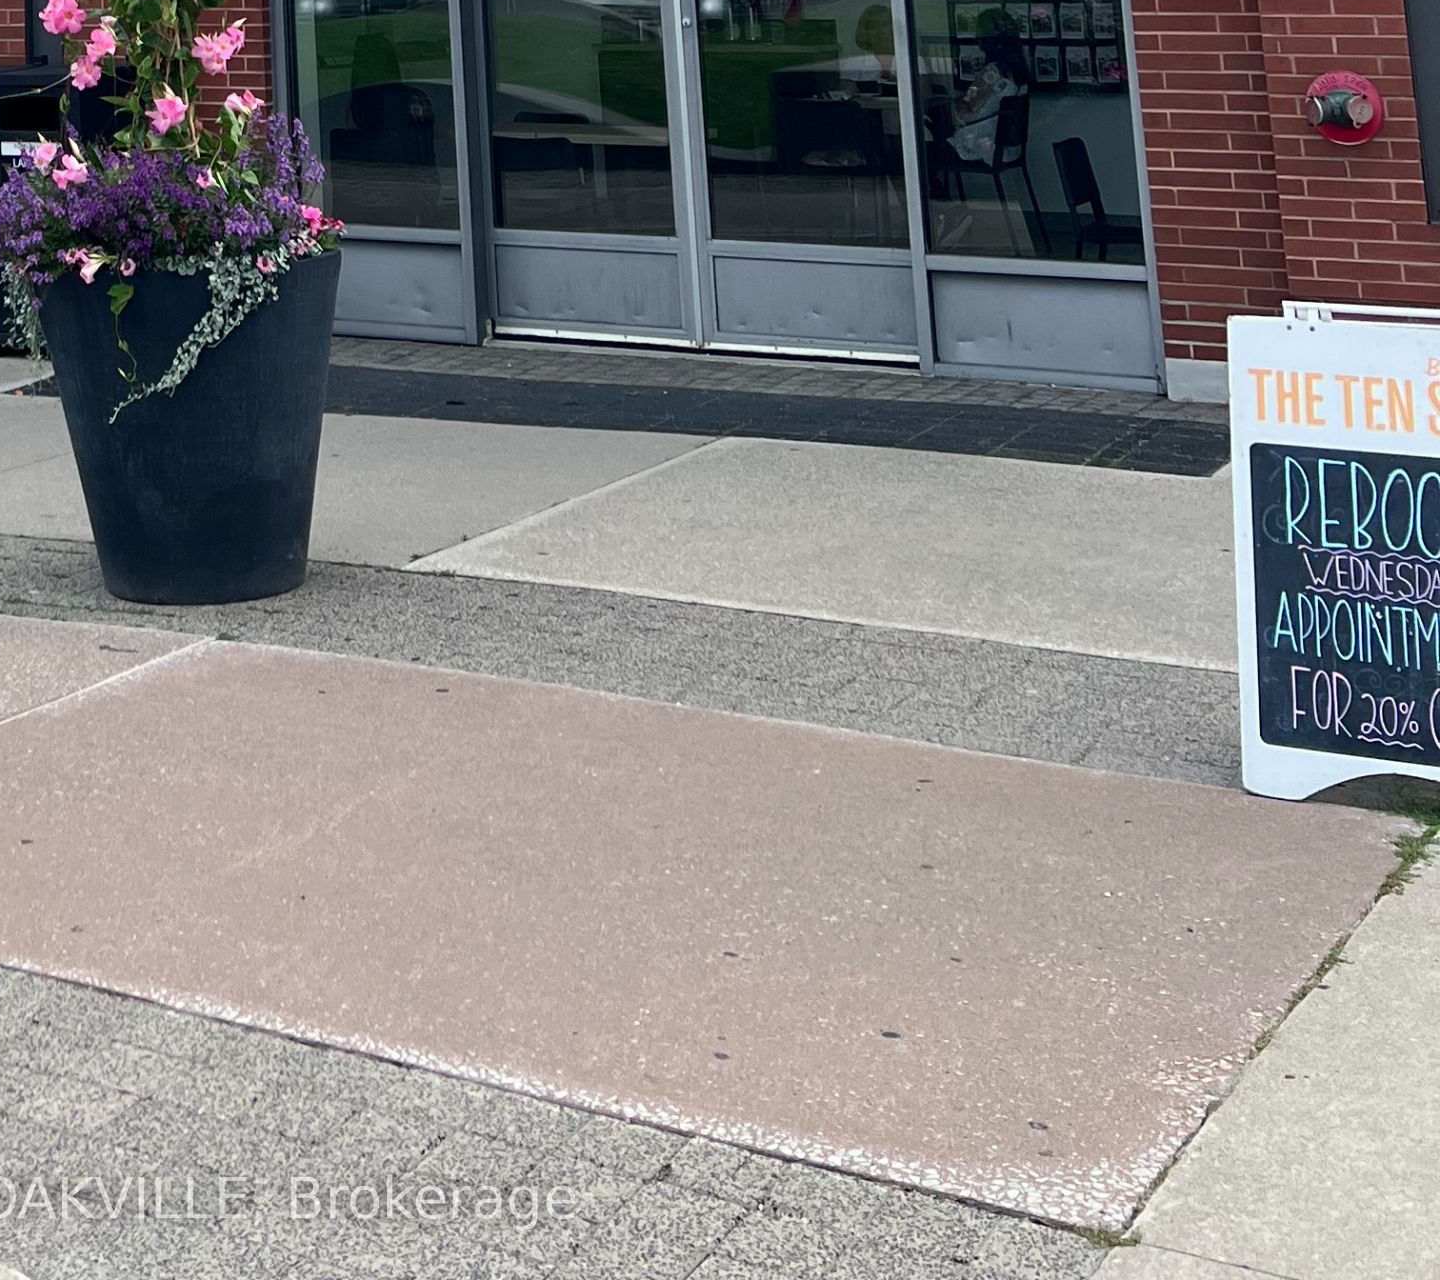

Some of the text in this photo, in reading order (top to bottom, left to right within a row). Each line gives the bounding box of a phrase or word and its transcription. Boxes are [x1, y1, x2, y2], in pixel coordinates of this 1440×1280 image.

[1248, 368, 1326, 426] THE
[1334, 375, 1415, 433] TEN
[1290, 665, 1353, 737] FOR
[1360, 692, 1419, 737] 20%
